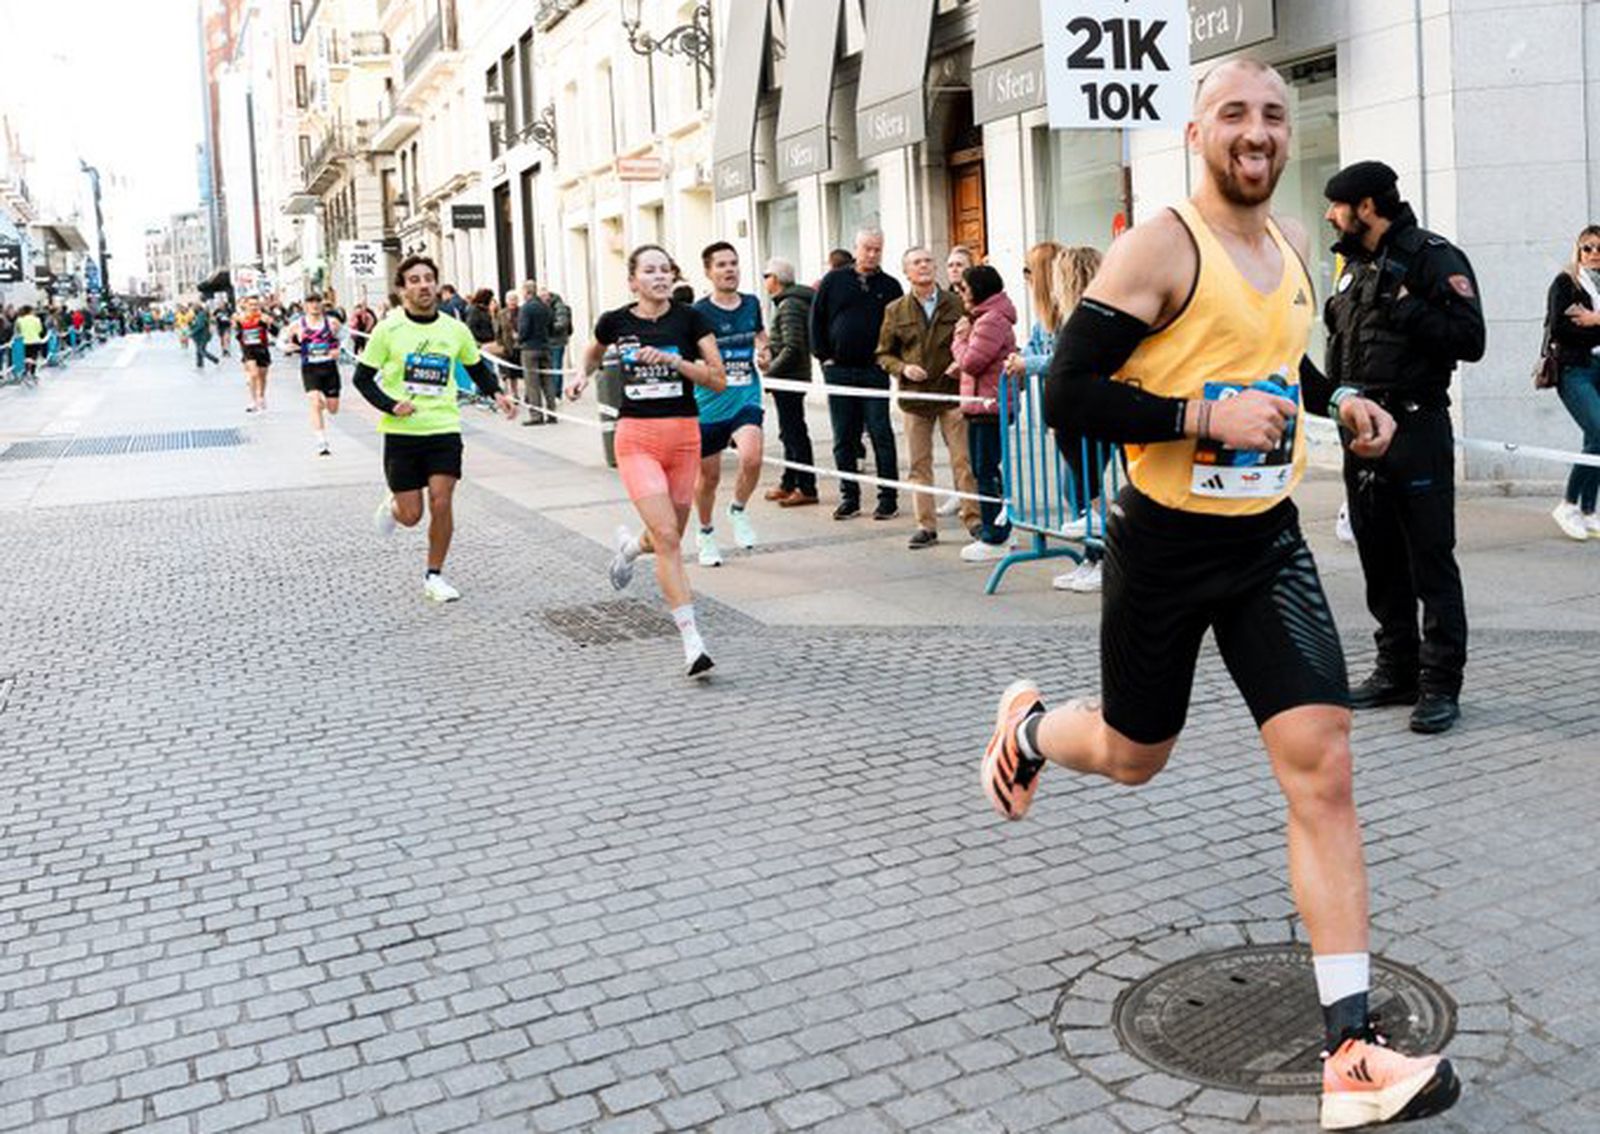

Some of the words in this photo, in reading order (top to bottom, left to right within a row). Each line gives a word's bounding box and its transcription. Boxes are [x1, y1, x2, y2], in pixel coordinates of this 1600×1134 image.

[1065, 17, 1171, 71] 21K
[1080, 82, 1161, 121] 10K
[350, 252, 377, 265] 21K
